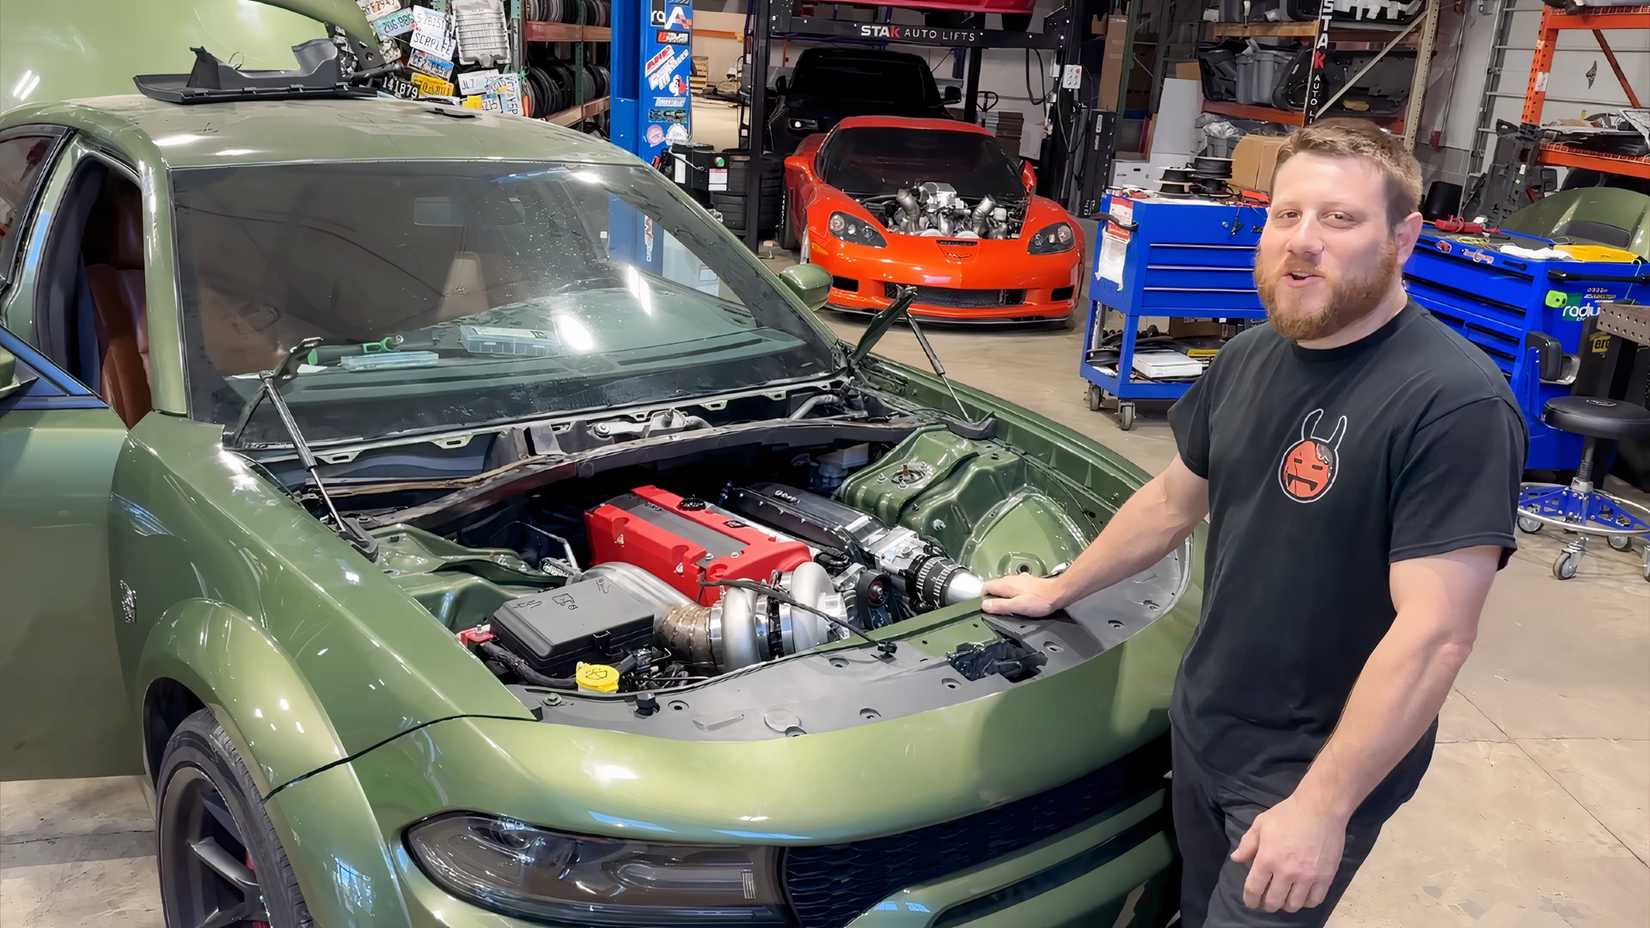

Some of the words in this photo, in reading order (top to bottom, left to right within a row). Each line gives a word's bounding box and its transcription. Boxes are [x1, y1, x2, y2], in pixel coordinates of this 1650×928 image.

[861, 25, 900, 38] STAK
[904, 28, 937, 39] AUTO
[942, 31, 976, 42] LIFTS
[1310, 74, 1320, 106] AUTO
